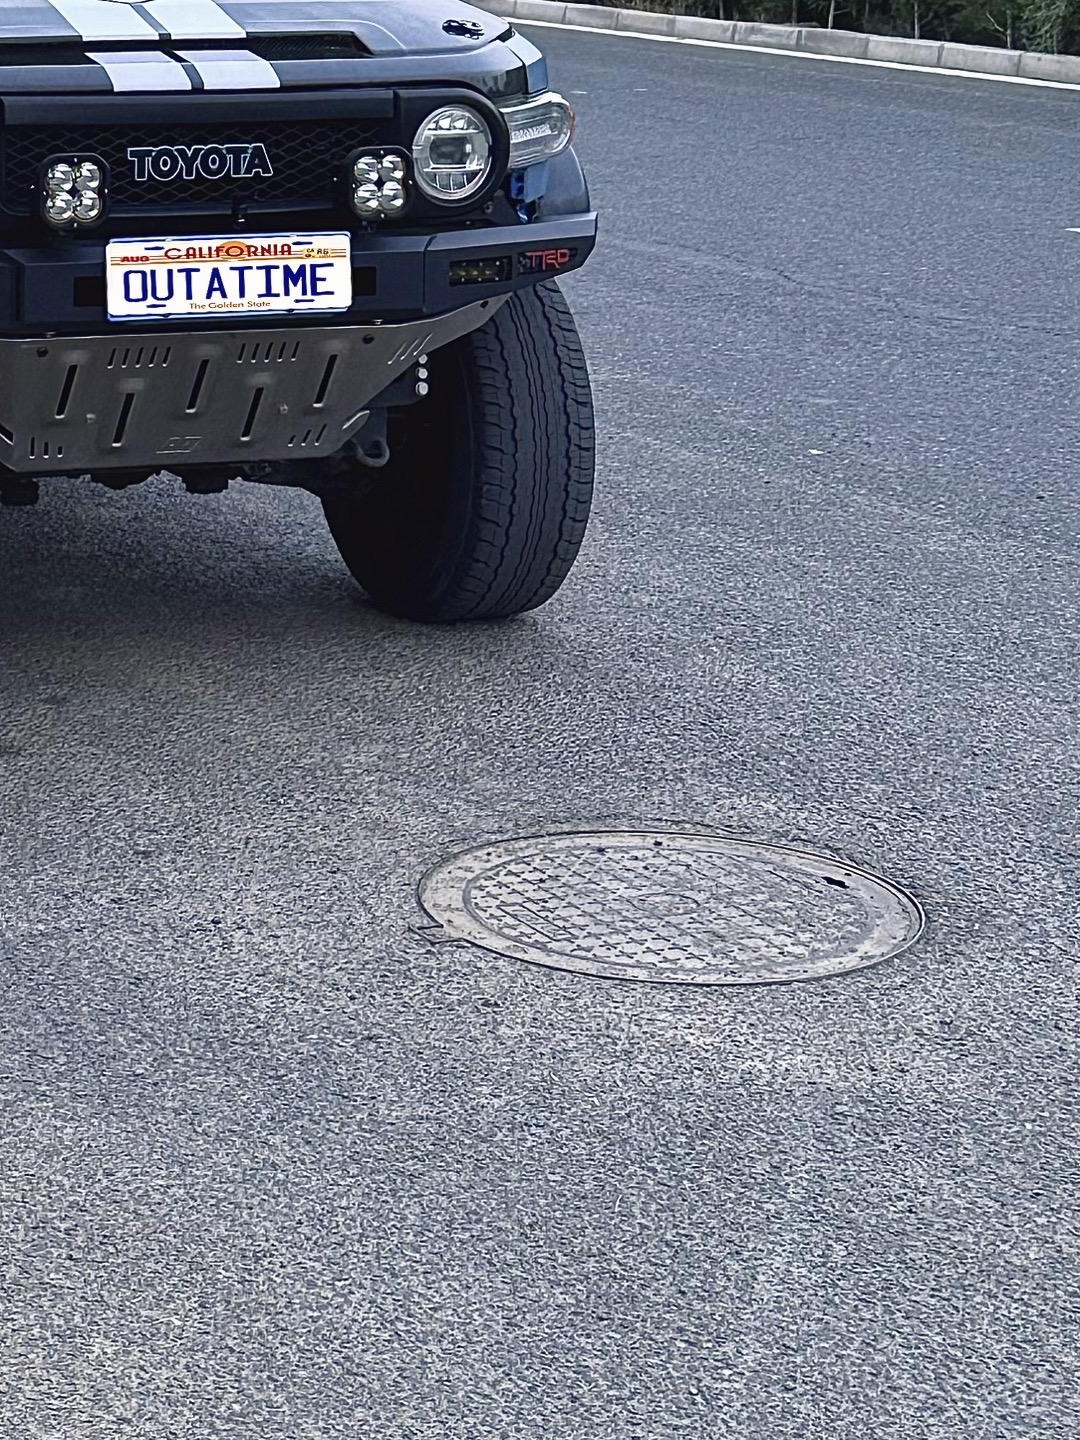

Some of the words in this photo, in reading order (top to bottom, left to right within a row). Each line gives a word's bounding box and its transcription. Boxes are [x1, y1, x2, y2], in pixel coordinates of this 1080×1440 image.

[127, 143, 274, 181] TOYOTA
[121, 255, 150, 263] AUG
[164, 243, 292, 260] CALIFORNIA
[525, 249, 569, 271] TRD
[123, 263, 335, 303] OUTATIME
